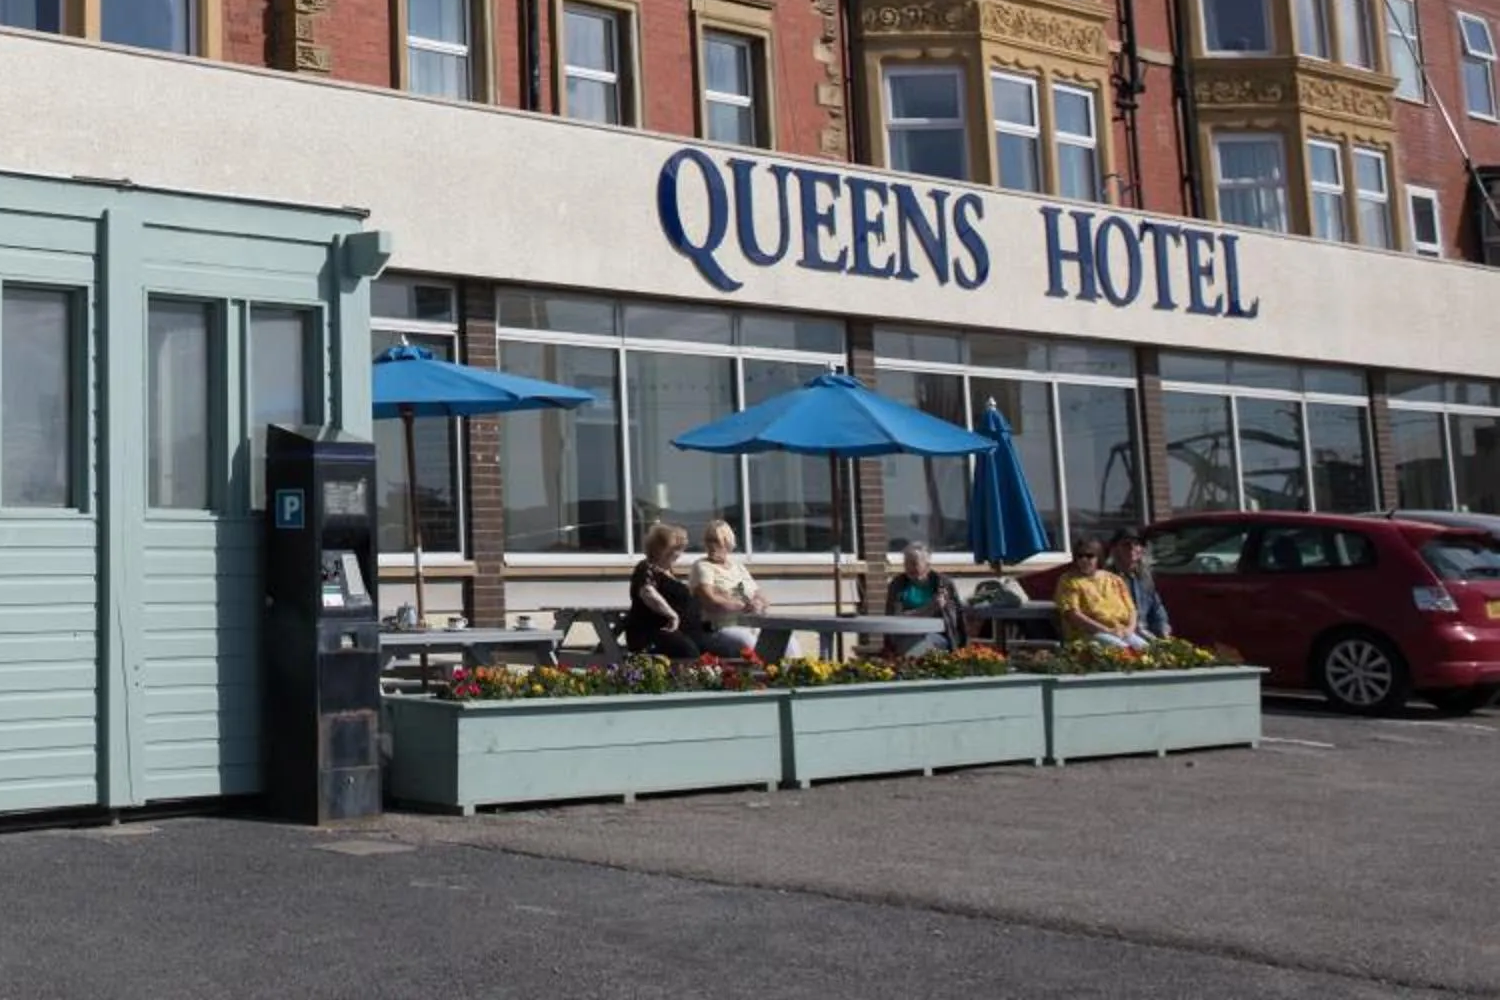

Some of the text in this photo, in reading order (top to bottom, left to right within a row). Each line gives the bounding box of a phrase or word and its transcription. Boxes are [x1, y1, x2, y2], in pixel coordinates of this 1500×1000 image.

[657, 147, 1260, 319] QUEENS HOTEL
[284, 496, 300, 521] P
